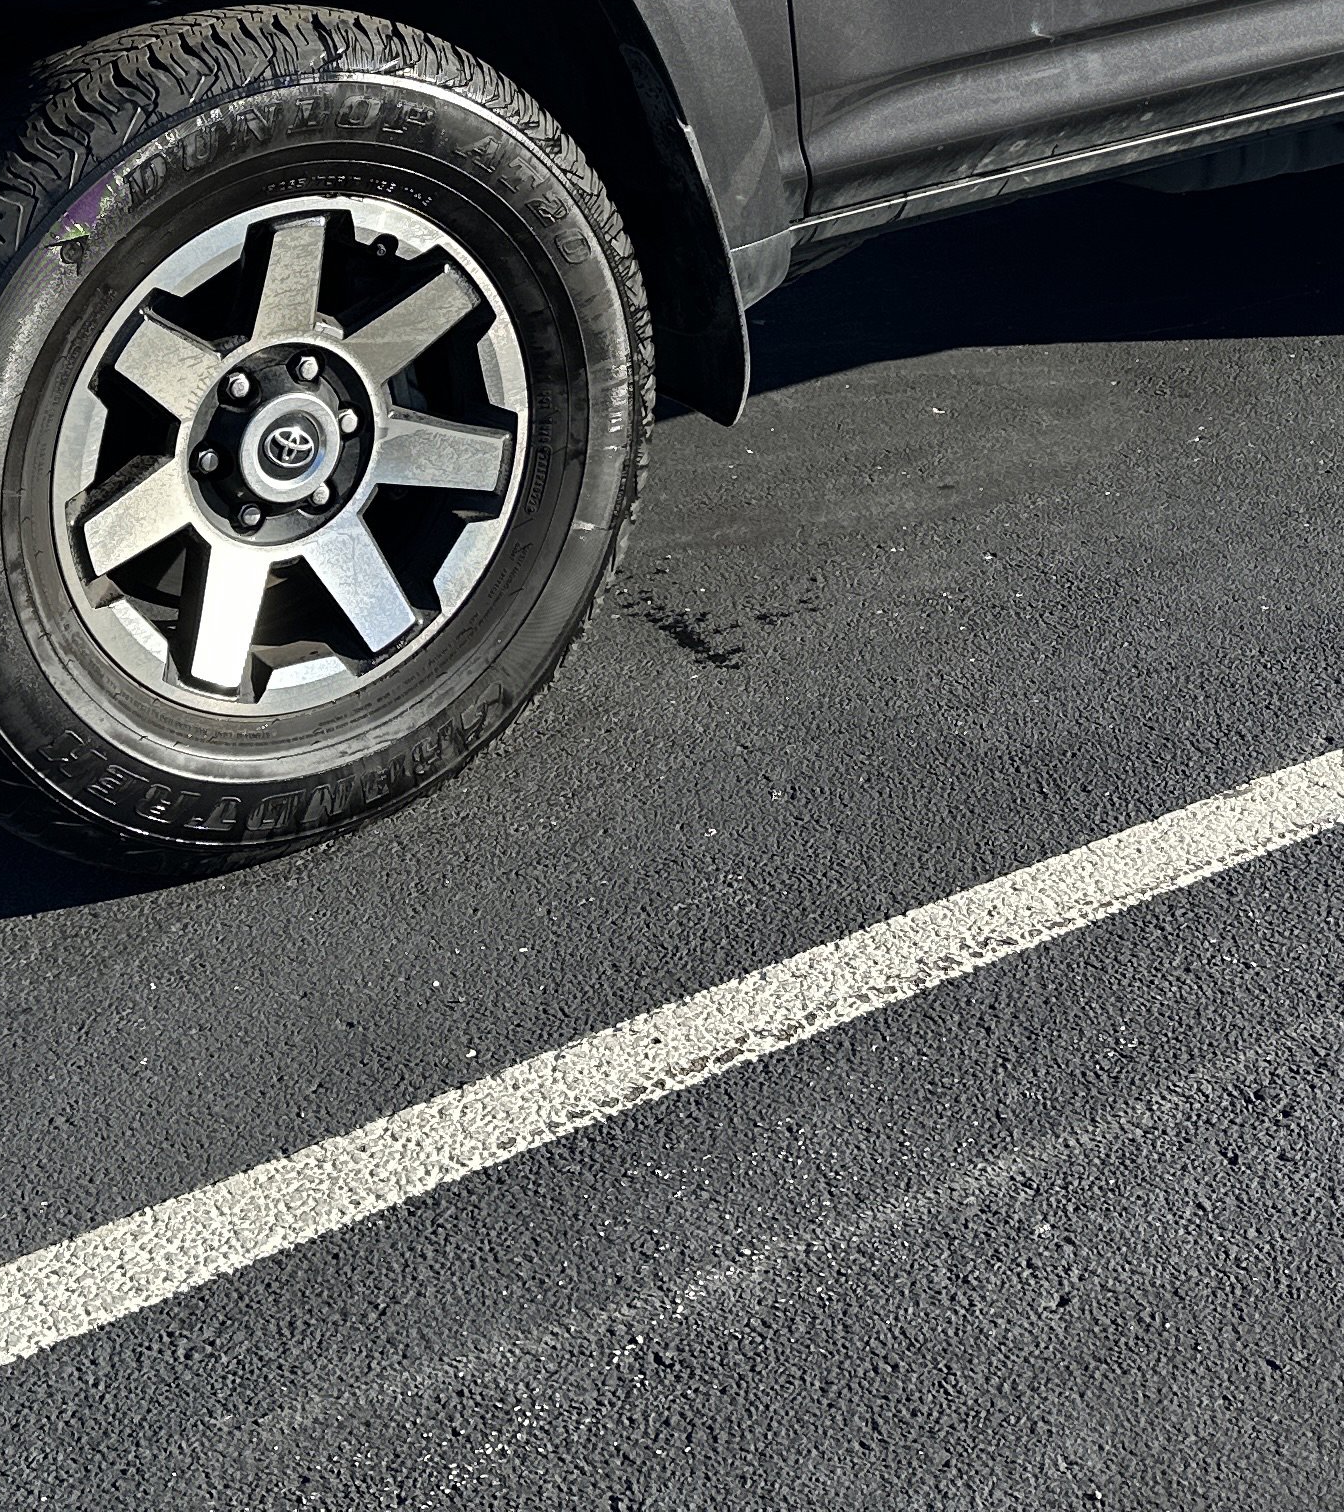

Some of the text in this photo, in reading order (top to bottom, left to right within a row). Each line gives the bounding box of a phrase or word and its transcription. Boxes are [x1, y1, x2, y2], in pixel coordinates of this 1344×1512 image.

[121, 94, 592, 265] DUNLOP AT20
[36, 681, 504, 832] GRANDTREK
